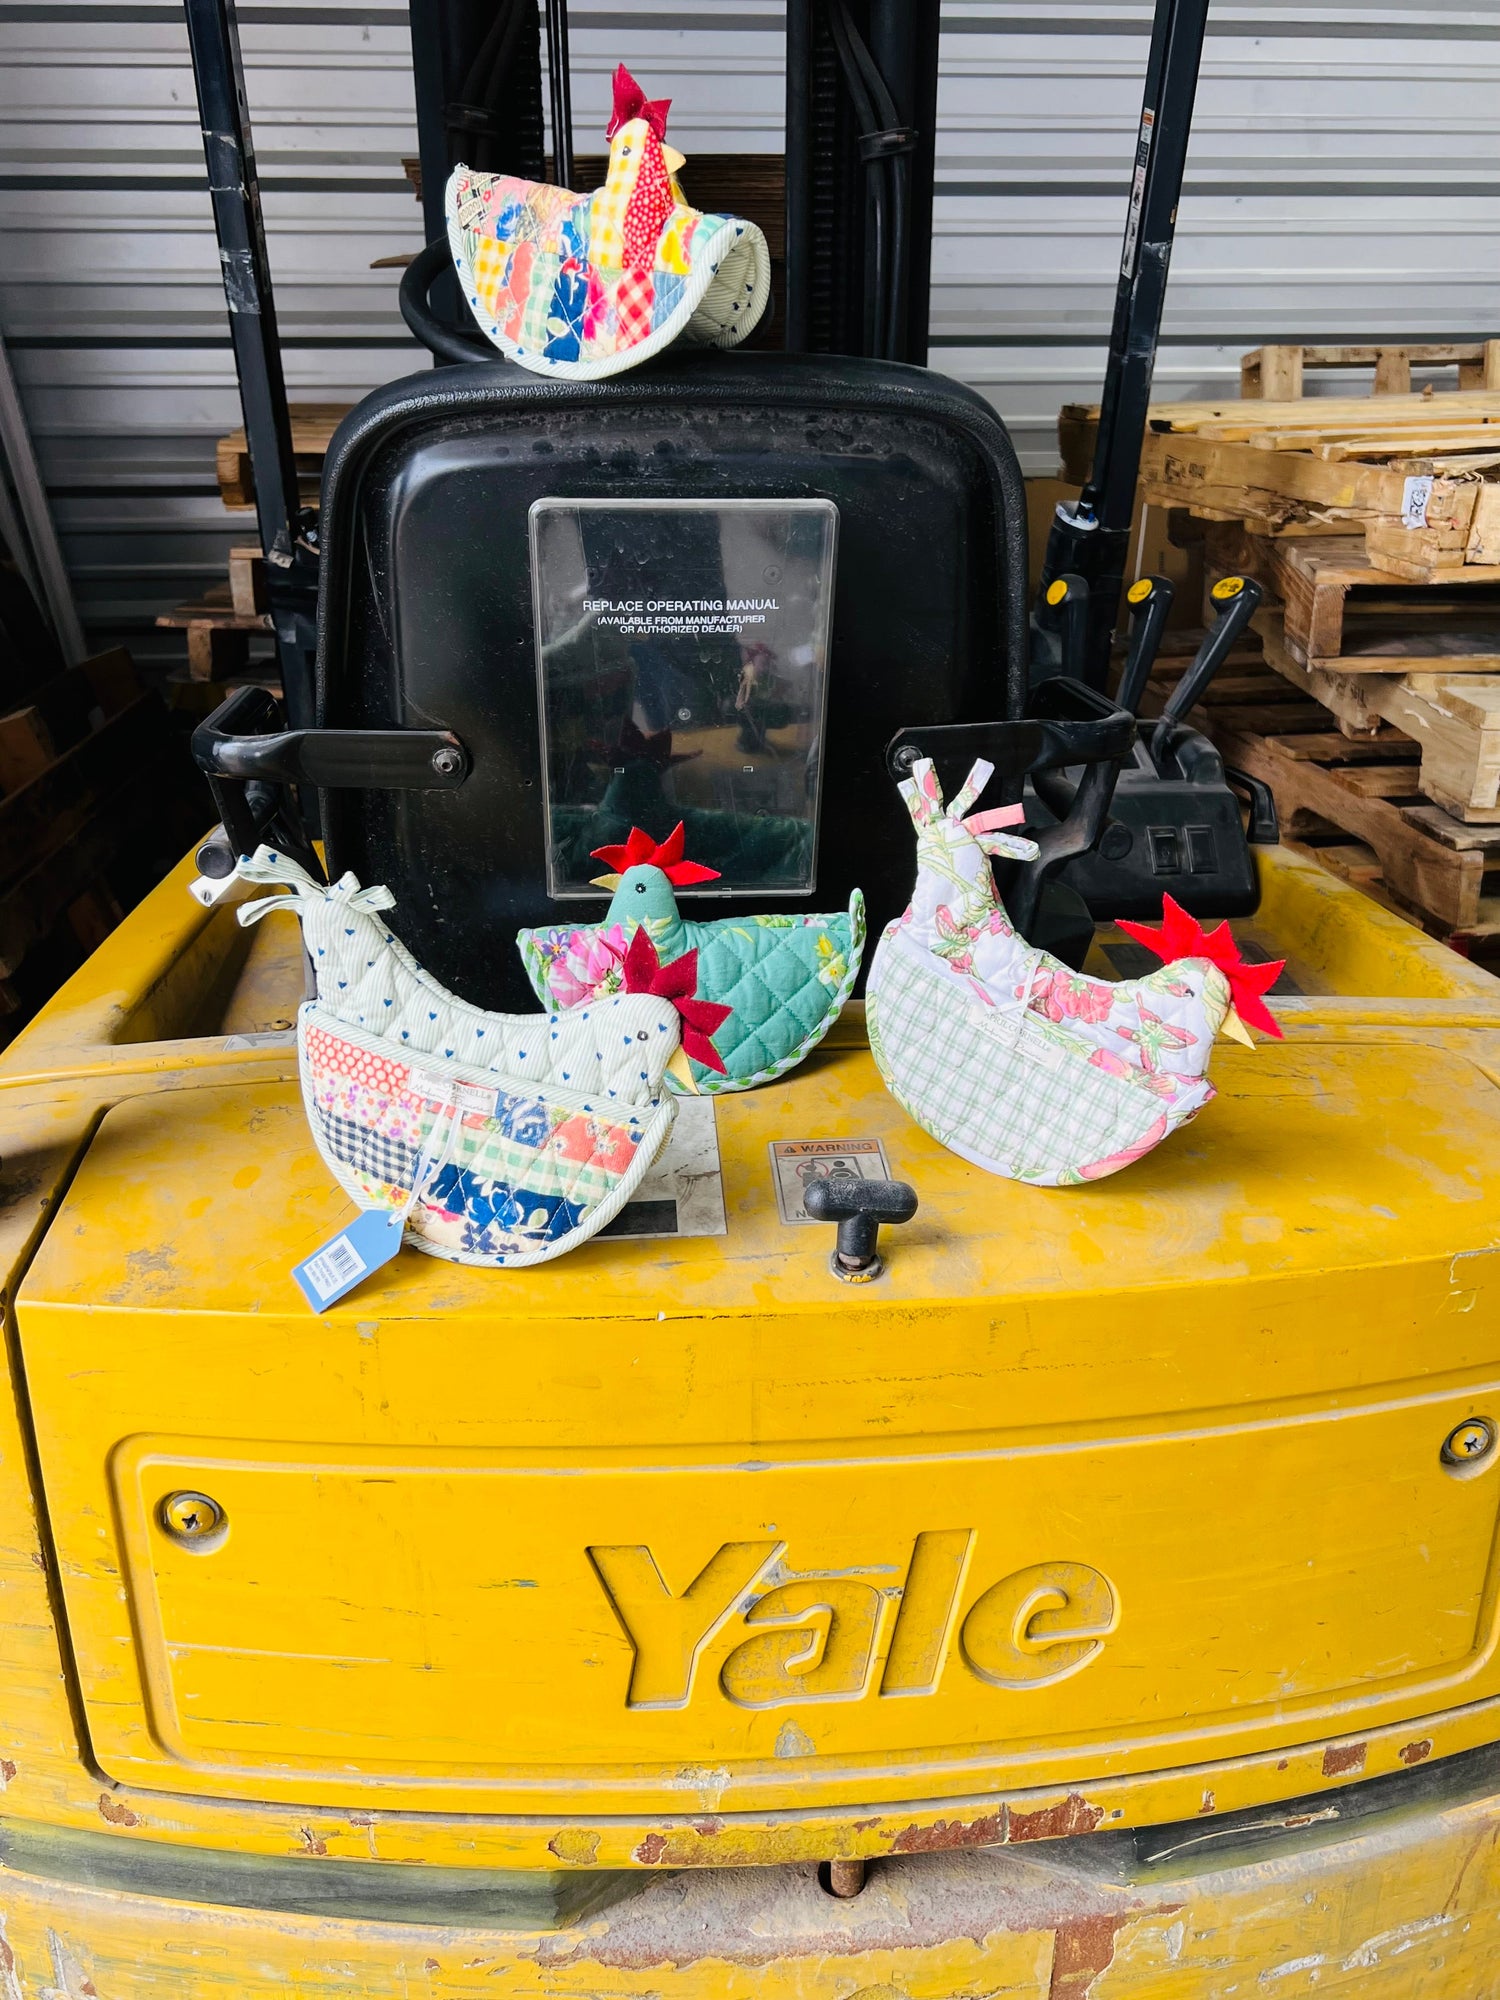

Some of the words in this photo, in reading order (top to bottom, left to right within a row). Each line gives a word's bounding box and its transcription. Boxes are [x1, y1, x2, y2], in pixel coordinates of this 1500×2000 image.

[583, 600, 644, 612] REPLACE
[646, 600, 723, 612] OPERATING
[726, 599, 780, 611] MANUAL
[597, 616, 652, 626] (AVAILABLE
[655, 616, 684, 625] FROM
[685, 615, 766, 625] MANUFACTURER
[620, 625, 635, 634] OR
[636, 625, 699, 634] AUTHORIZED
[701, 624, 743, 634] DEALER)
[800, 1143, 873, 1153] WARNING
[584, 1528, 1122, 1711] Yale
